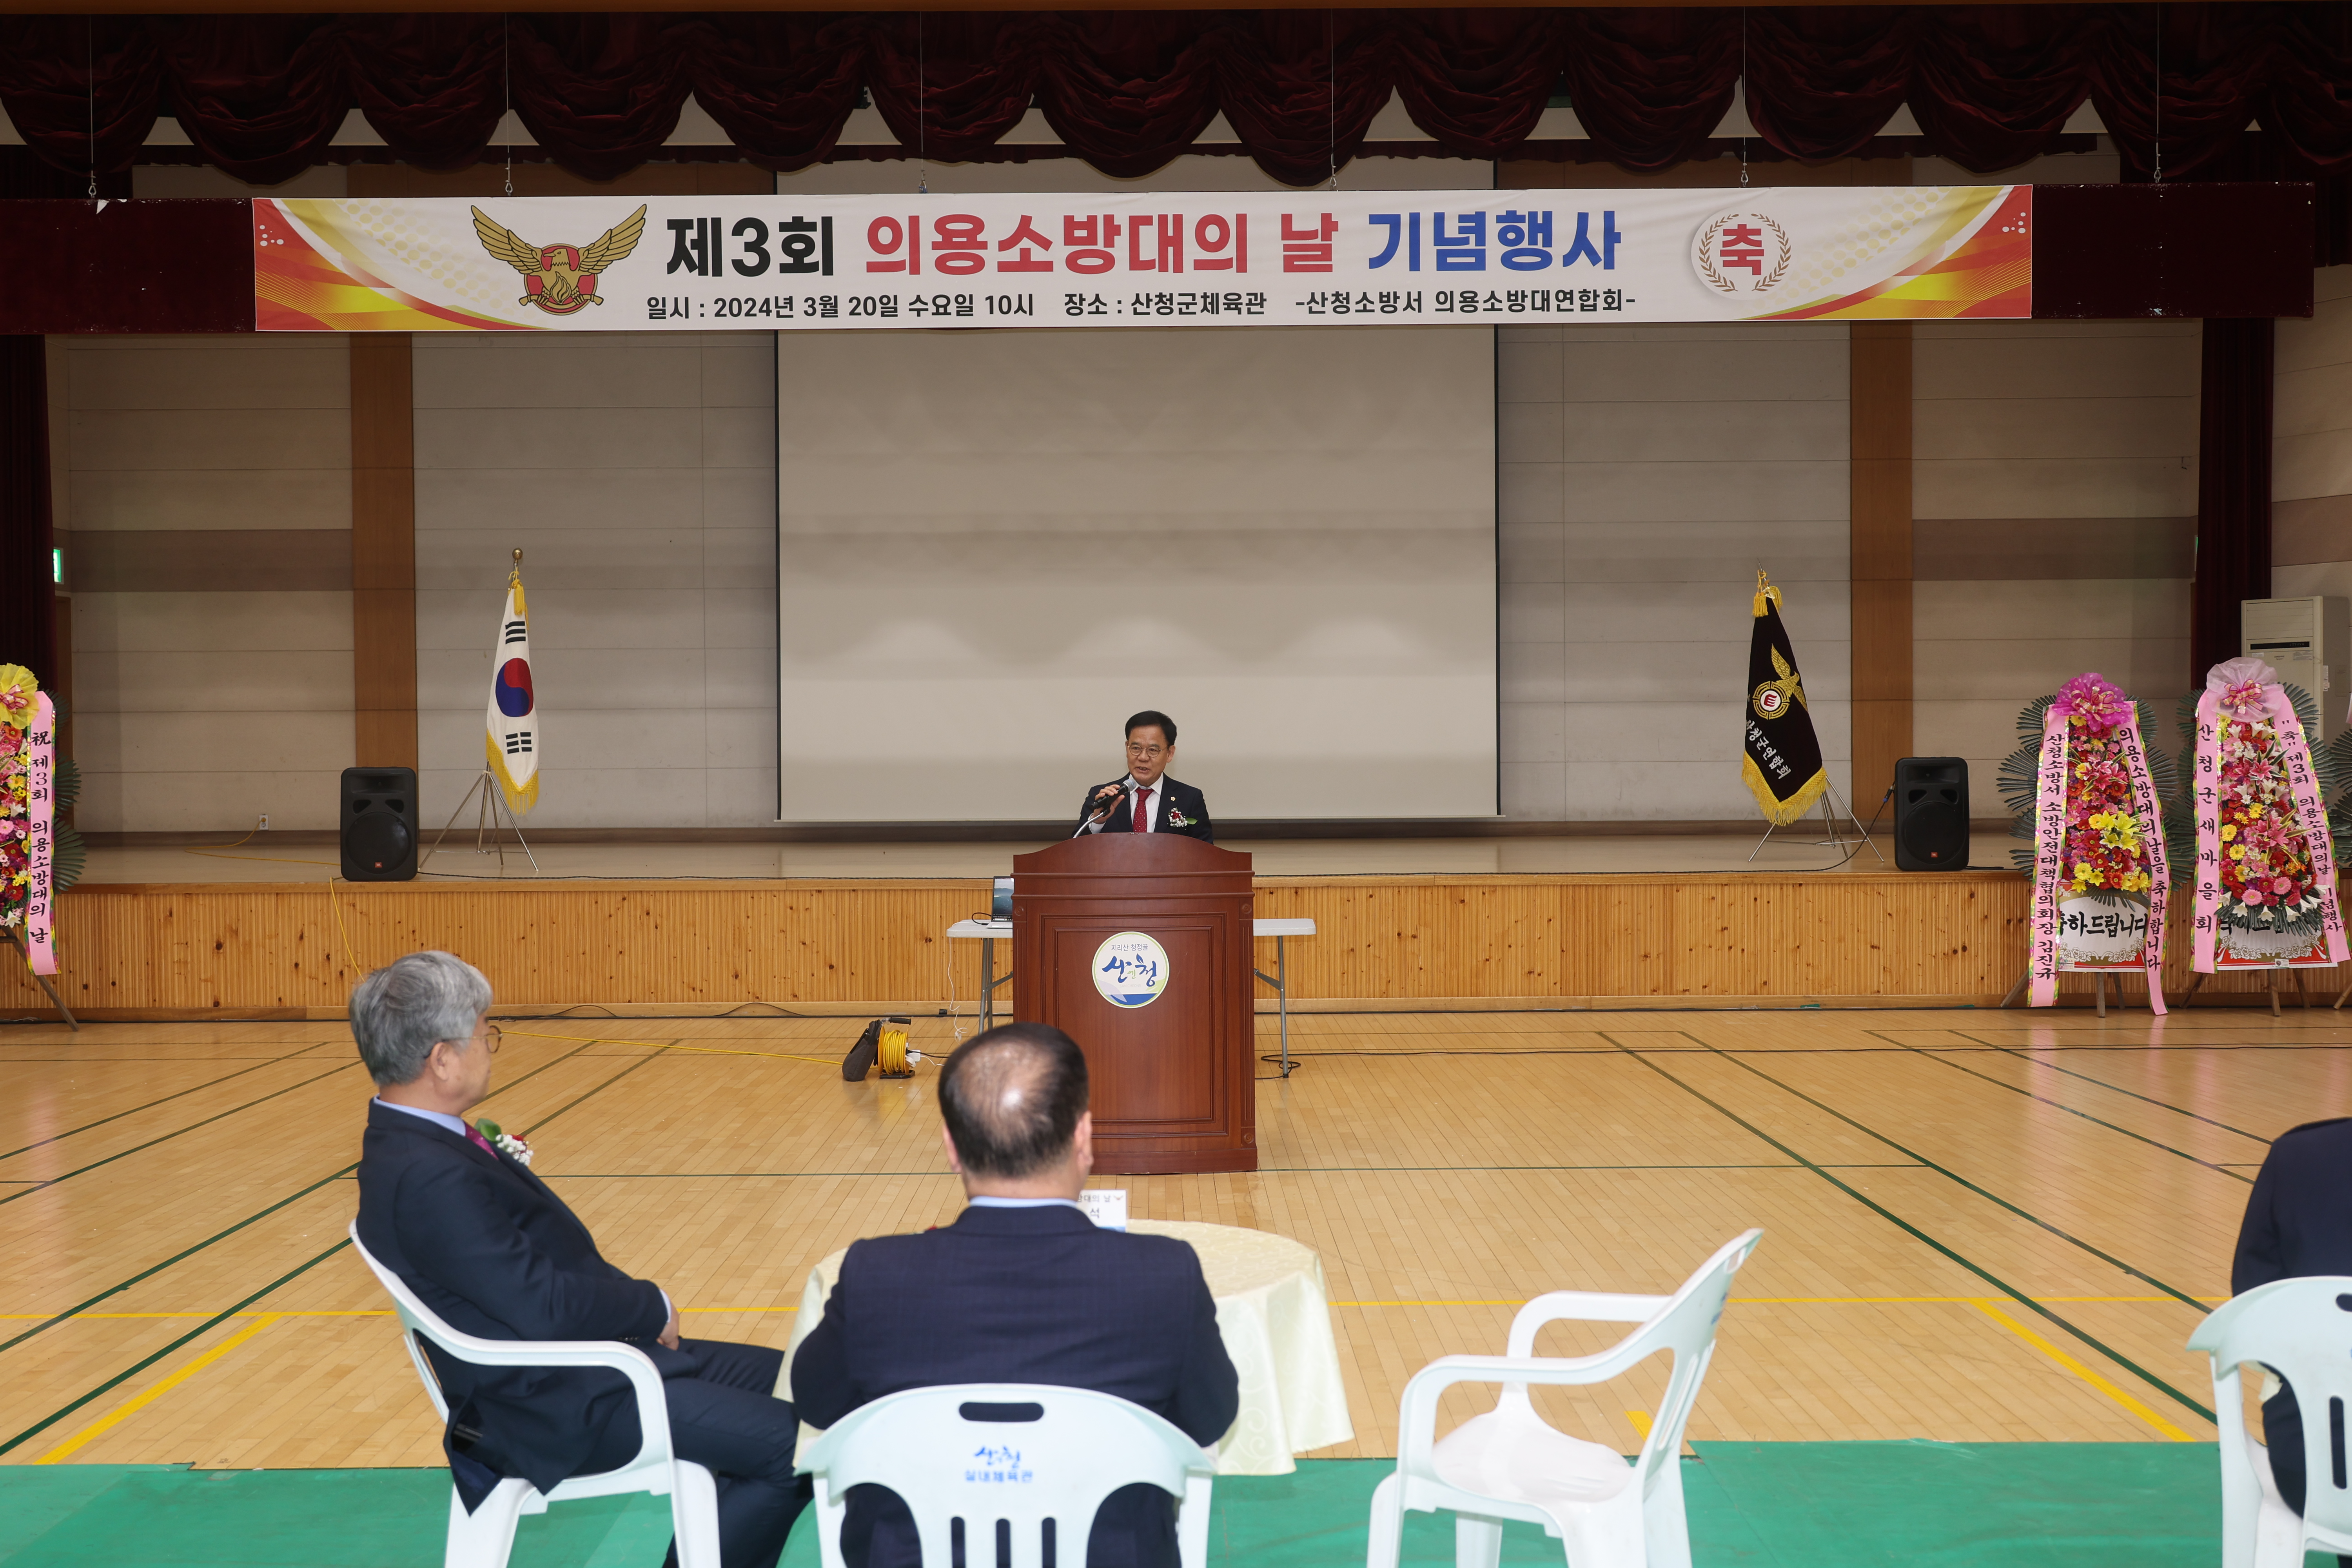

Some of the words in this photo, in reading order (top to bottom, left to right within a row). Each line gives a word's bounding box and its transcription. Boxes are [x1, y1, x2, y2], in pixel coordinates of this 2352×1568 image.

[666, 216, 834, 277] 제3회
[866, 213, 1248, 276] 의용소방대의
[1281, 212, 1339, 273] 날
[1369, 210, 1621, 272] 기념행사
[1722, 224, 1764, 276] 축
[647, 296, 690, 320] 일시
[713, 295, 794, 319] 2024년
[803, 295, 839, 318] 3월
[848, 294, 898, 318] 20일
[908, 294, 974, 318] 수요일
[985, 293, 1034, 316] 10시
[1064, 293, 1108, 316] 장소
[1131, 292, 1267, 316] 산청군체육관
[1295, 291, 1422, 315] -산청소방서
[1435, 288, 1636, 314] 의용소방대연합회-
[31, 731, 51, 746] 祝
[31, 755, 48, 802] 제3회
[2043, 733, 2065, 796] 산청소방서
[2286, 752, 2309, 784] 제3회
[29, 820, 50, 917] 의용소방대의
[2036, 801, 2063, 935] 소방안전대책협의회장
[29, 927, 49, 944] 날
[2147, 880, 2167, 972] 축하합니다
[2035, 940, 2055, 980] 김진규
